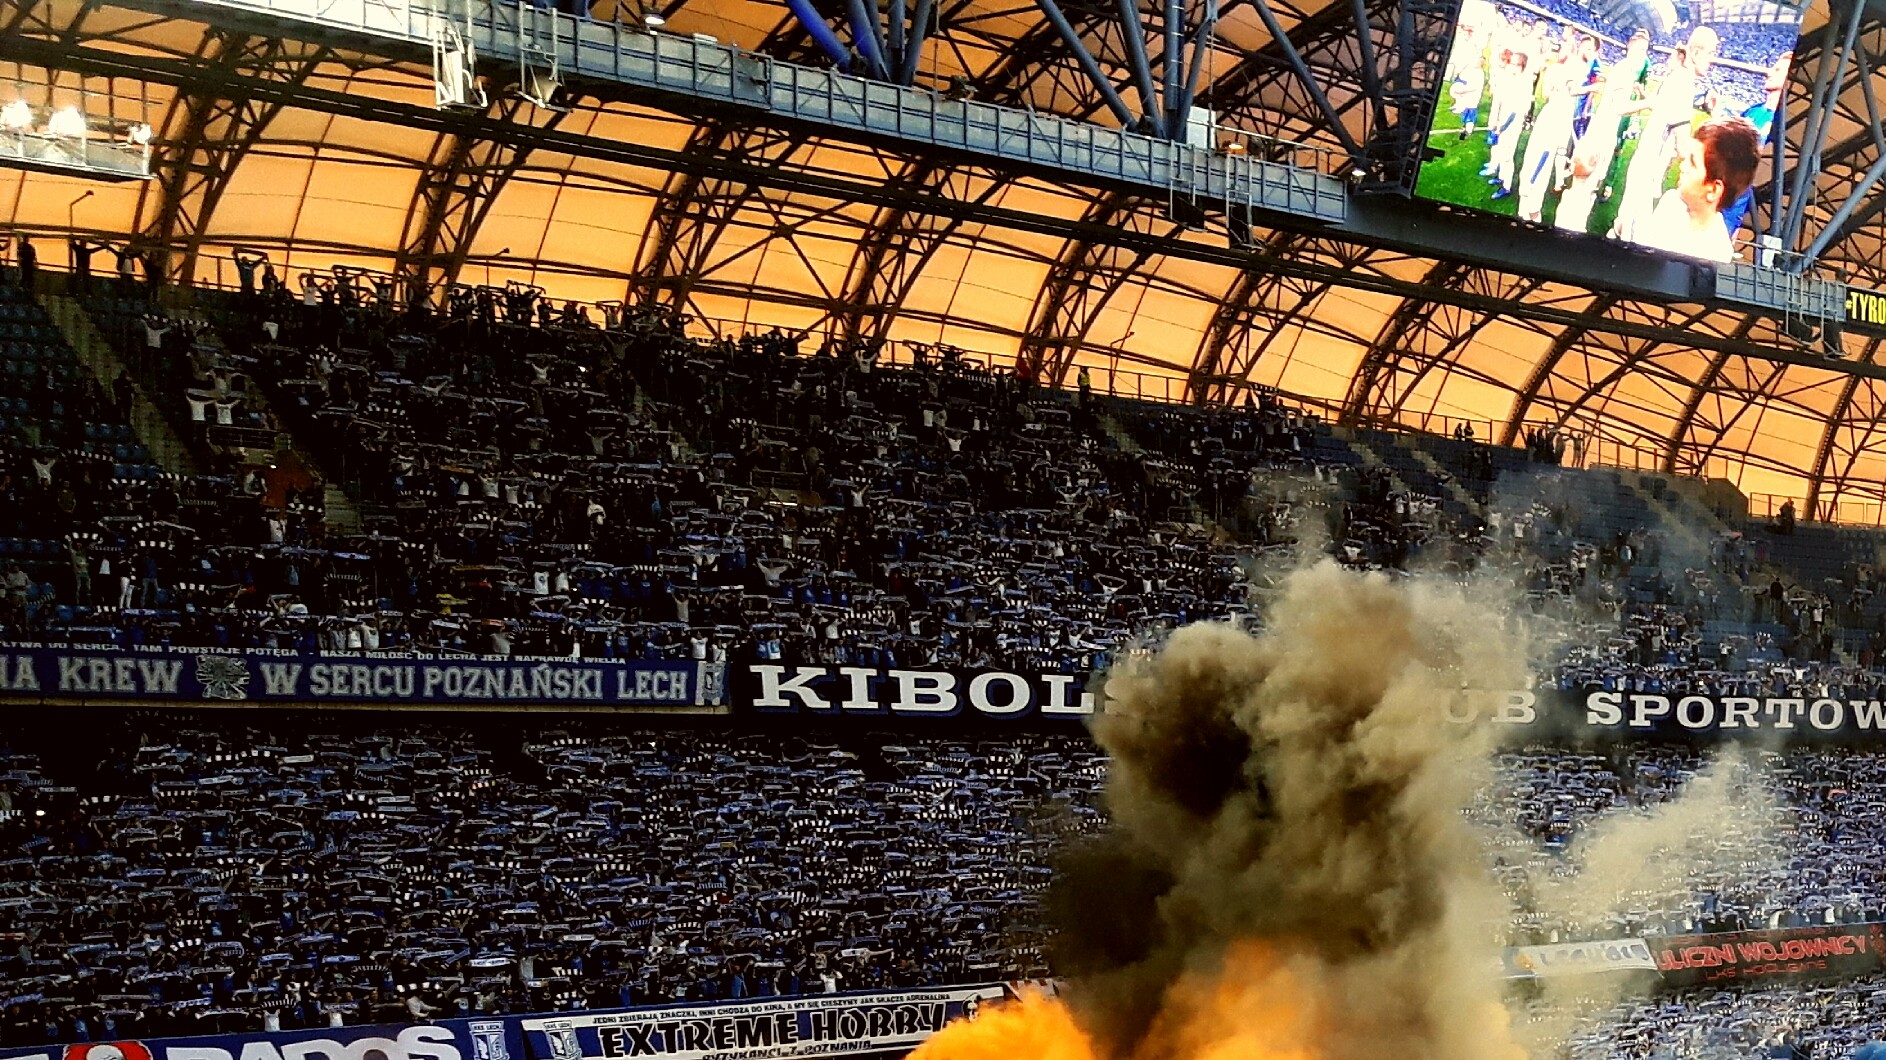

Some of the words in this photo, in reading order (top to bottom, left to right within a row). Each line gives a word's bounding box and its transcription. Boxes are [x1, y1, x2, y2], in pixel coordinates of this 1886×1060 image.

[57, 656, 184, 694] KREW
[260, 662, 303, 695] W
[310, 663, 415, 698] SERCU
[422, 662, 604, 700] POZNAŃSKI
[616, 669, 688, 701] LECH
[1655, 943, 1738, 971] ULICZNI
[1738, 935, 1866, 962] WOJOWNICY
[600, 1012, 798, 1059] EXTREME
[810, 1002, 946, 1043] HOBBY
